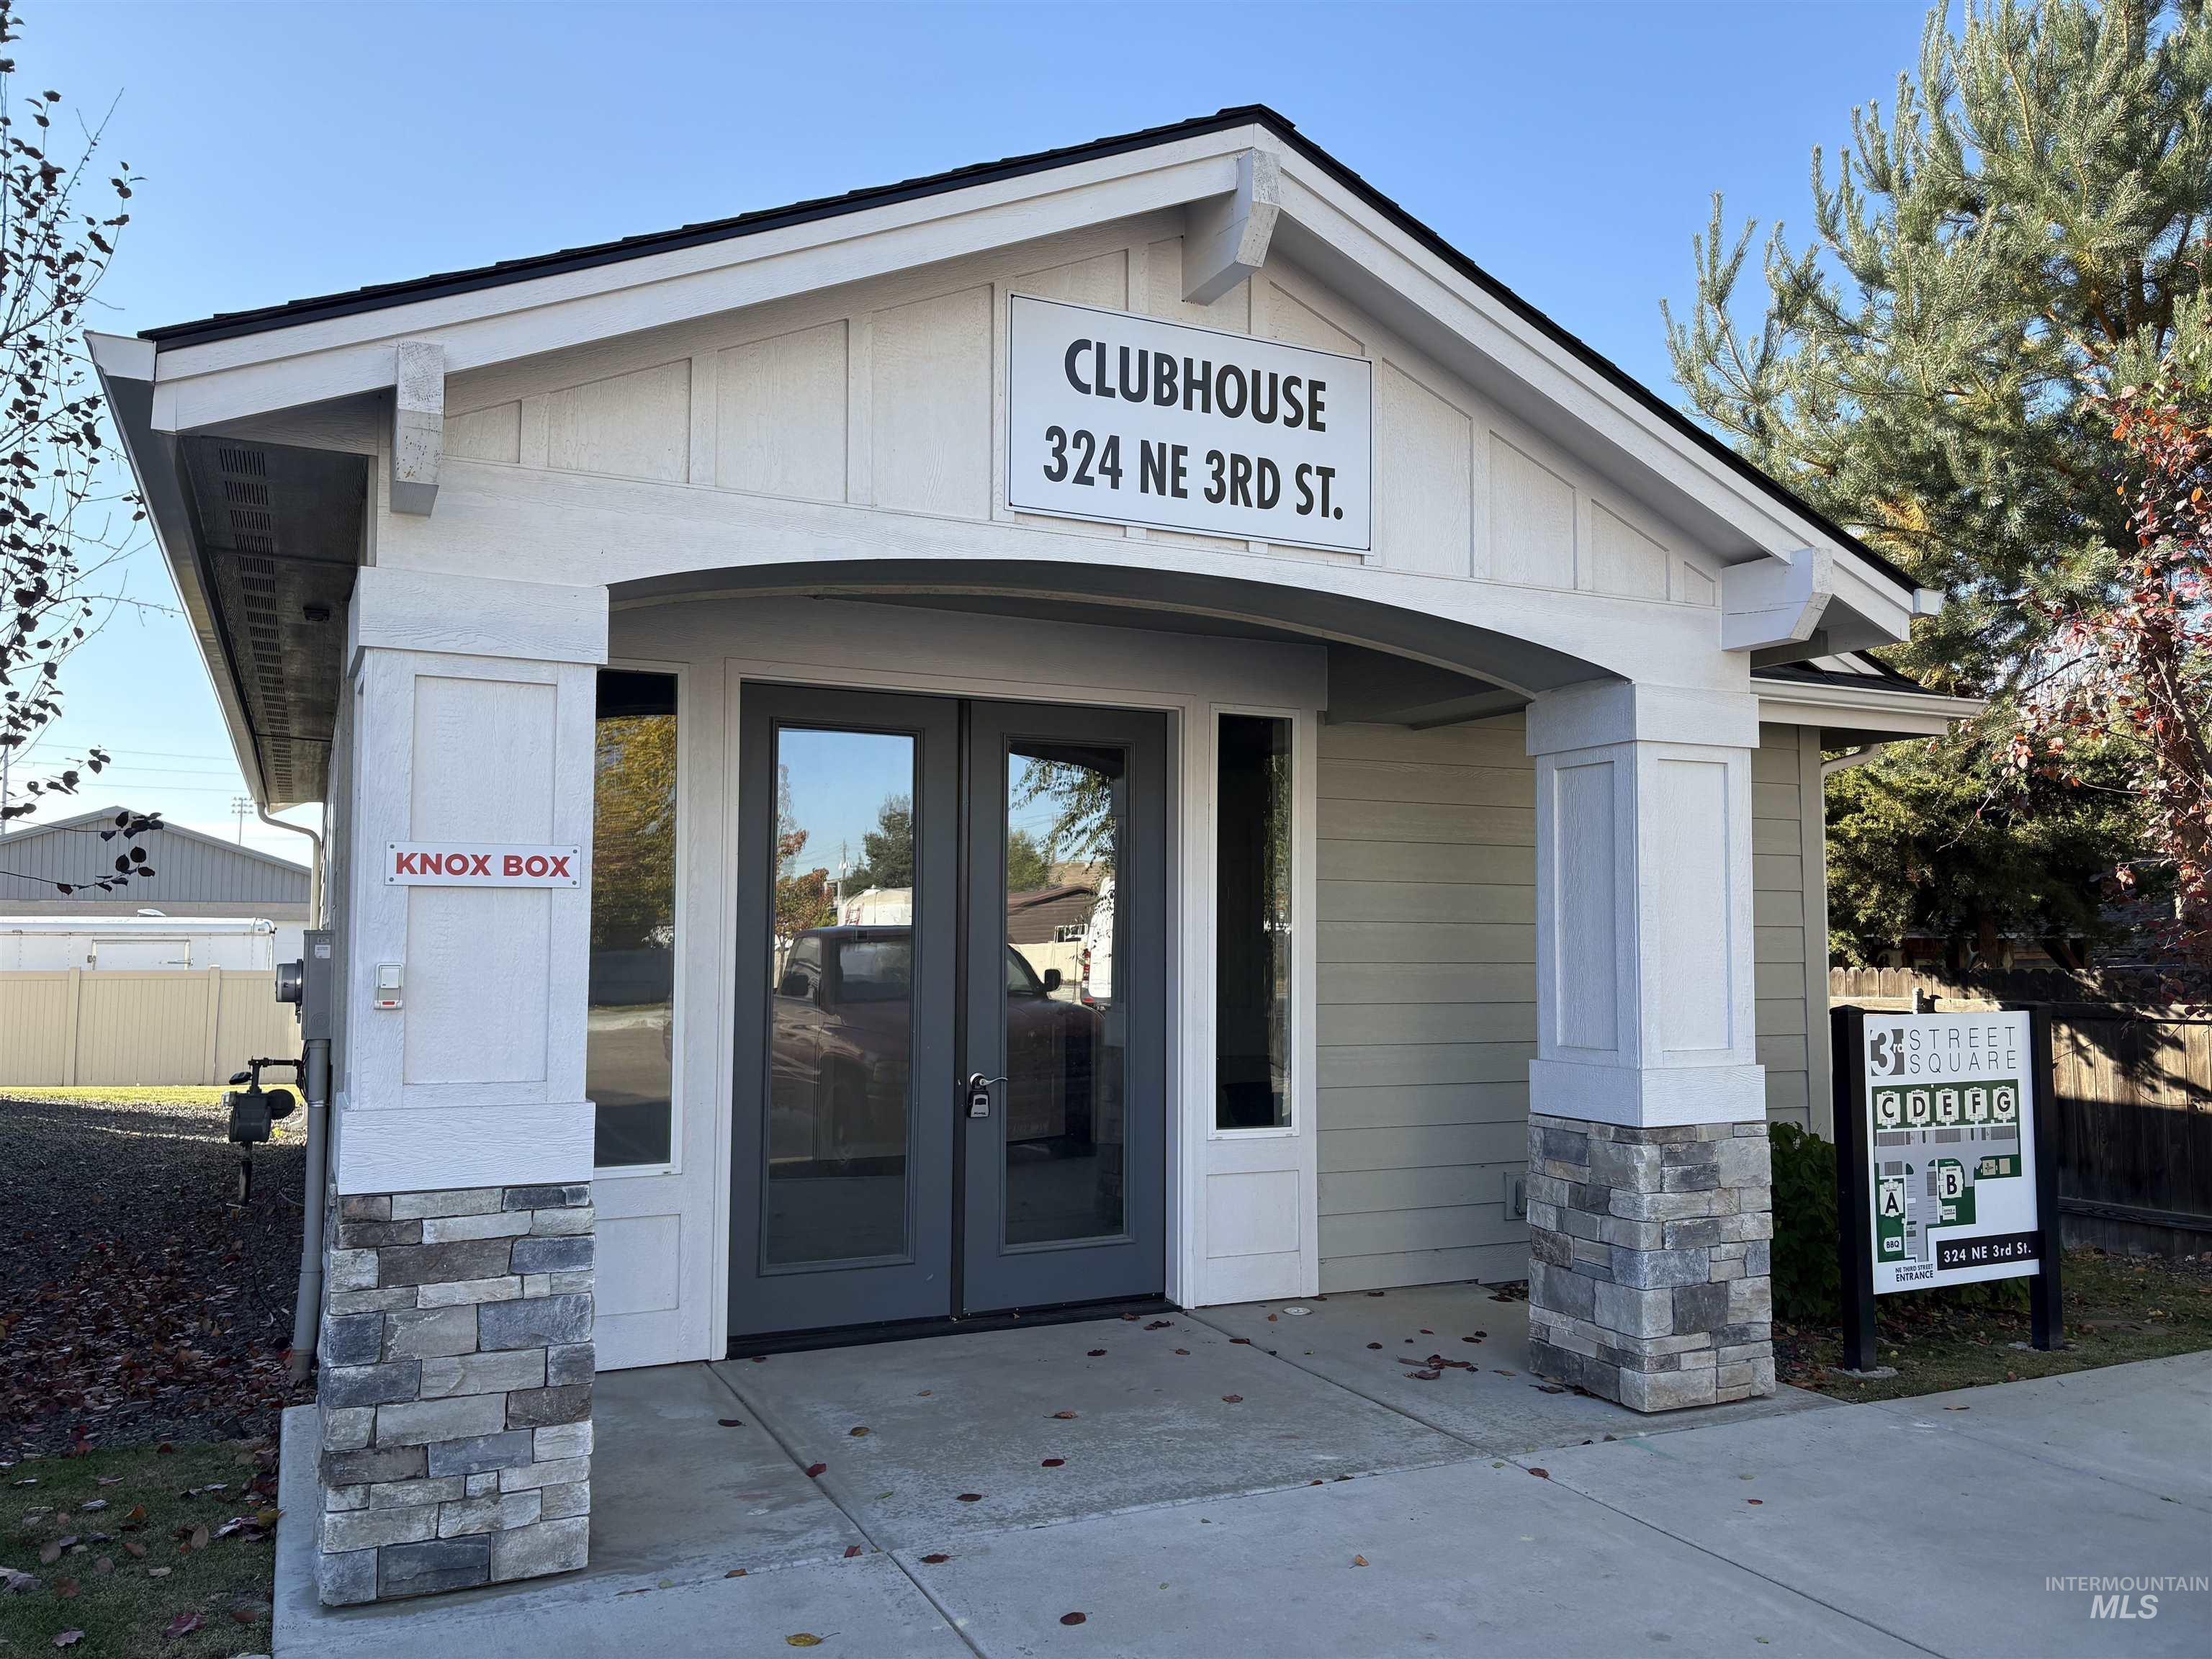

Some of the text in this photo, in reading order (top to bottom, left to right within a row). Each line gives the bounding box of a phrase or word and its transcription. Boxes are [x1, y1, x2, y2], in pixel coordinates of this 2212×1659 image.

[1064, 338, 1326, 433] CLUBHOUSE
[1043, 425, 1344, 521] 324 NE 3RD ST.
[395, 852, 571, 878] KNOX BOX
[1909, 1026, 2016, 1051] STREET
[1910, 1050, 2016, 1074] SQUARE
[1881, 1097, 1894, 1118] C
[1912, 1096, 1925, 1117] D
[1943, 1094, 1952, 1115] E
[1972, 1093, 1981, 1114] F
[1997, 1092, 2011, 1112] G
[1946, 1174, 1958, 1195] B
[1884, 1192, 1900, 1214] A
[1886, 1240, 1899, 1249] BBQ
[1943, 1241, 2031, 1263] 324 NE 3rd St.
[1896, 1270, 1933, 1282] ENTRANCE
